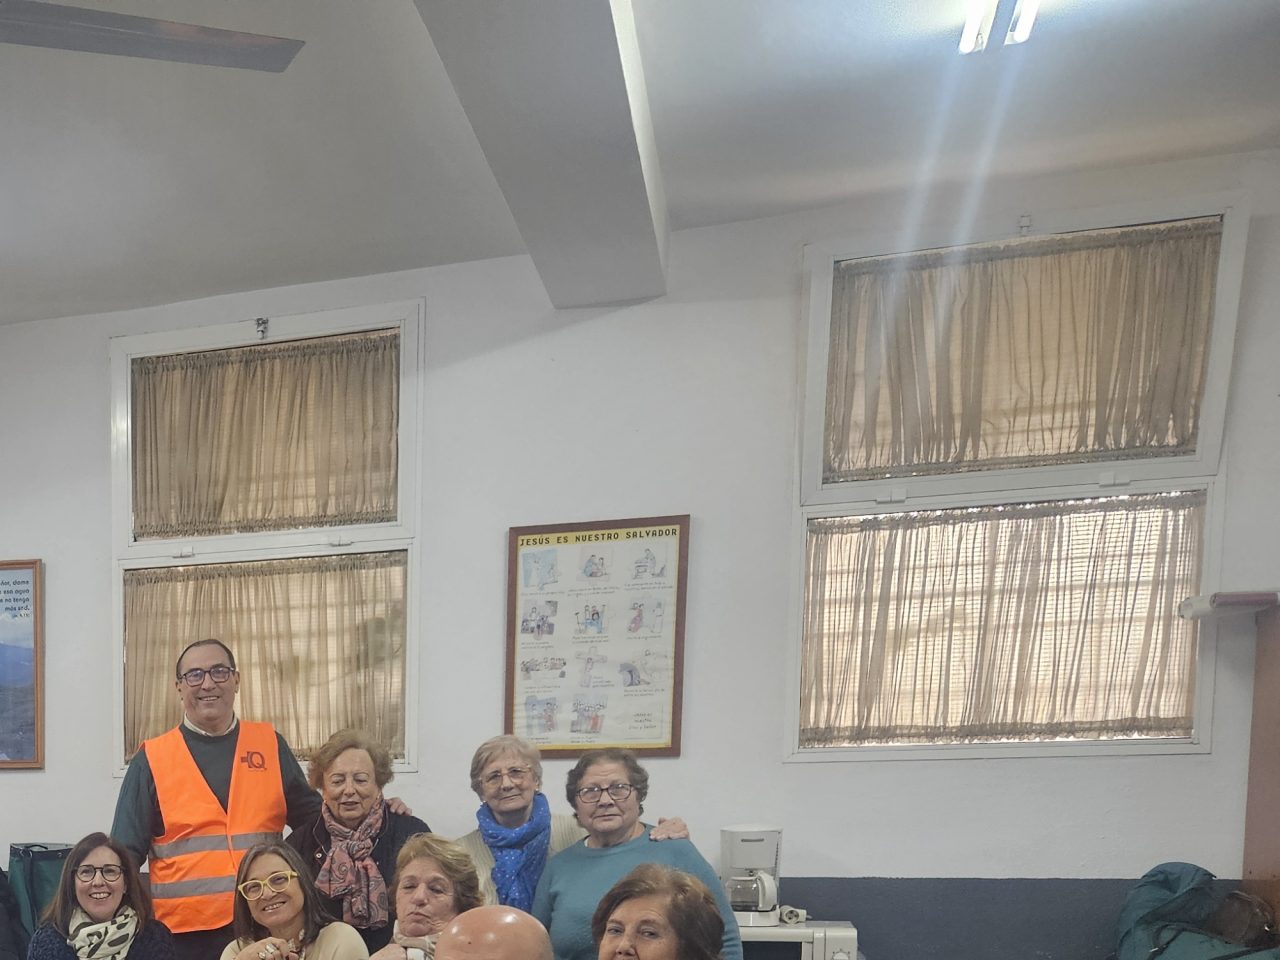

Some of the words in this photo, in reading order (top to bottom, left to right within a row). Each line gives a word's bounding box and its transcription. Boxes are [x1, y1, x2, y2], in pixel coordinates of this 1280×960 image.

[520, 534, 550, 547] JESÚS
[556, 535, 569, 544] ES
[575, 532, 620, 543] NUESTRO
[625, 528, 678, 539] SALVADOR
